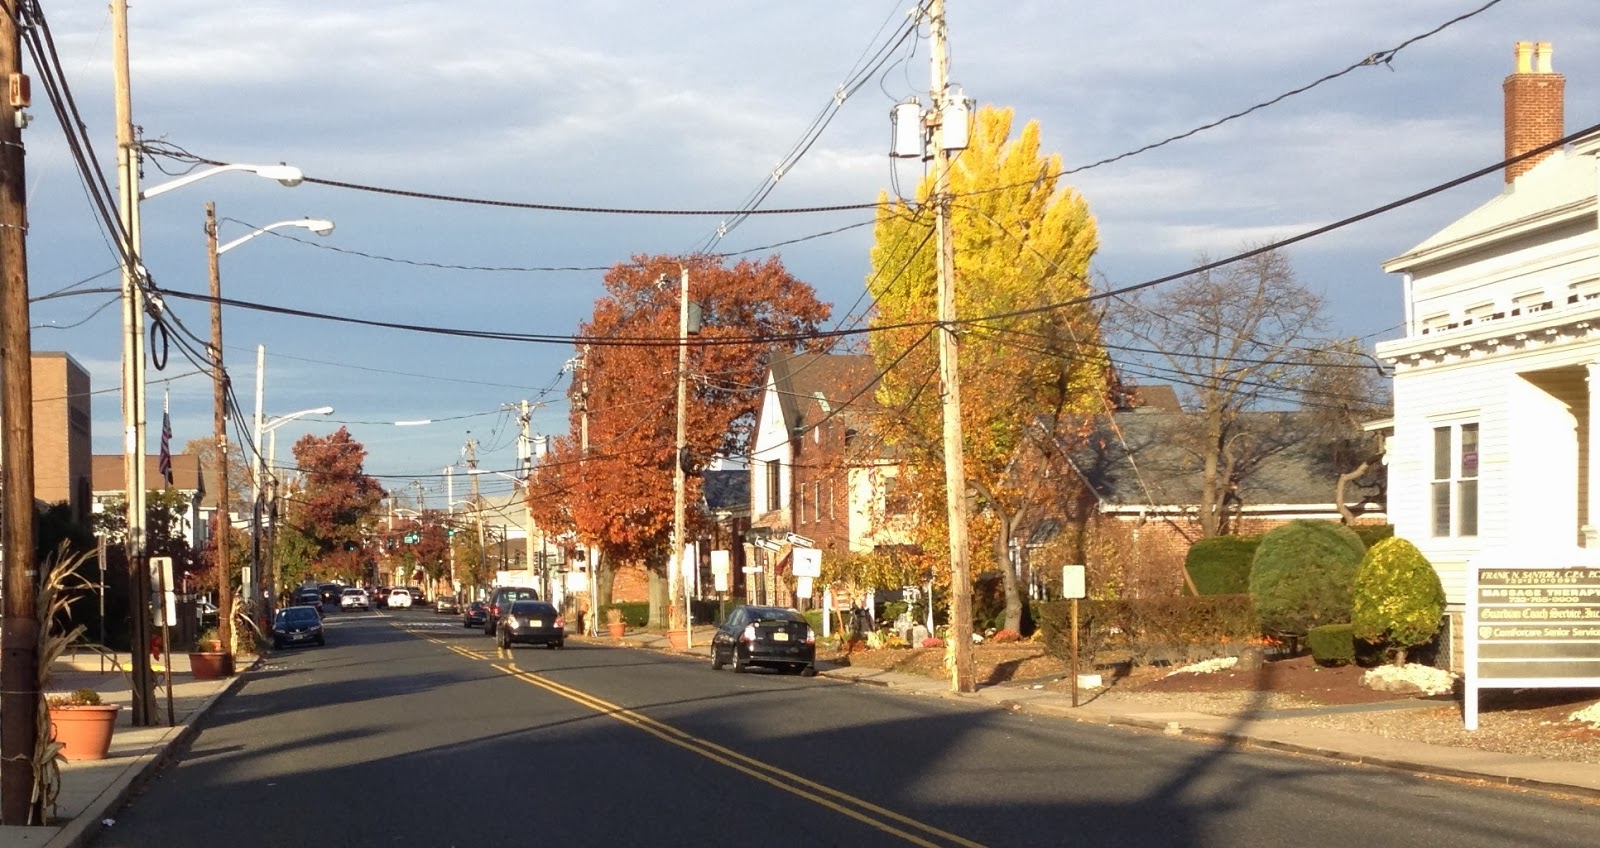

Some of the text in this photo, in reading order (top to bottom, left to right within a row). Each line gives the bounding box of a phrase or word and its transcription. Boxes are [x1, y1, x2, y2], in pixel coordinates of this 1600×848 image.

[1481, 571, 1509, 579] FRANK
[1481, 589, 1600, 597] MASSAGE THERAPY
[1481, 608, 1521, 619] Guardian
[1522, 608, 1548, 620] Coach
[1544, 627, 1571, 636] Senior
